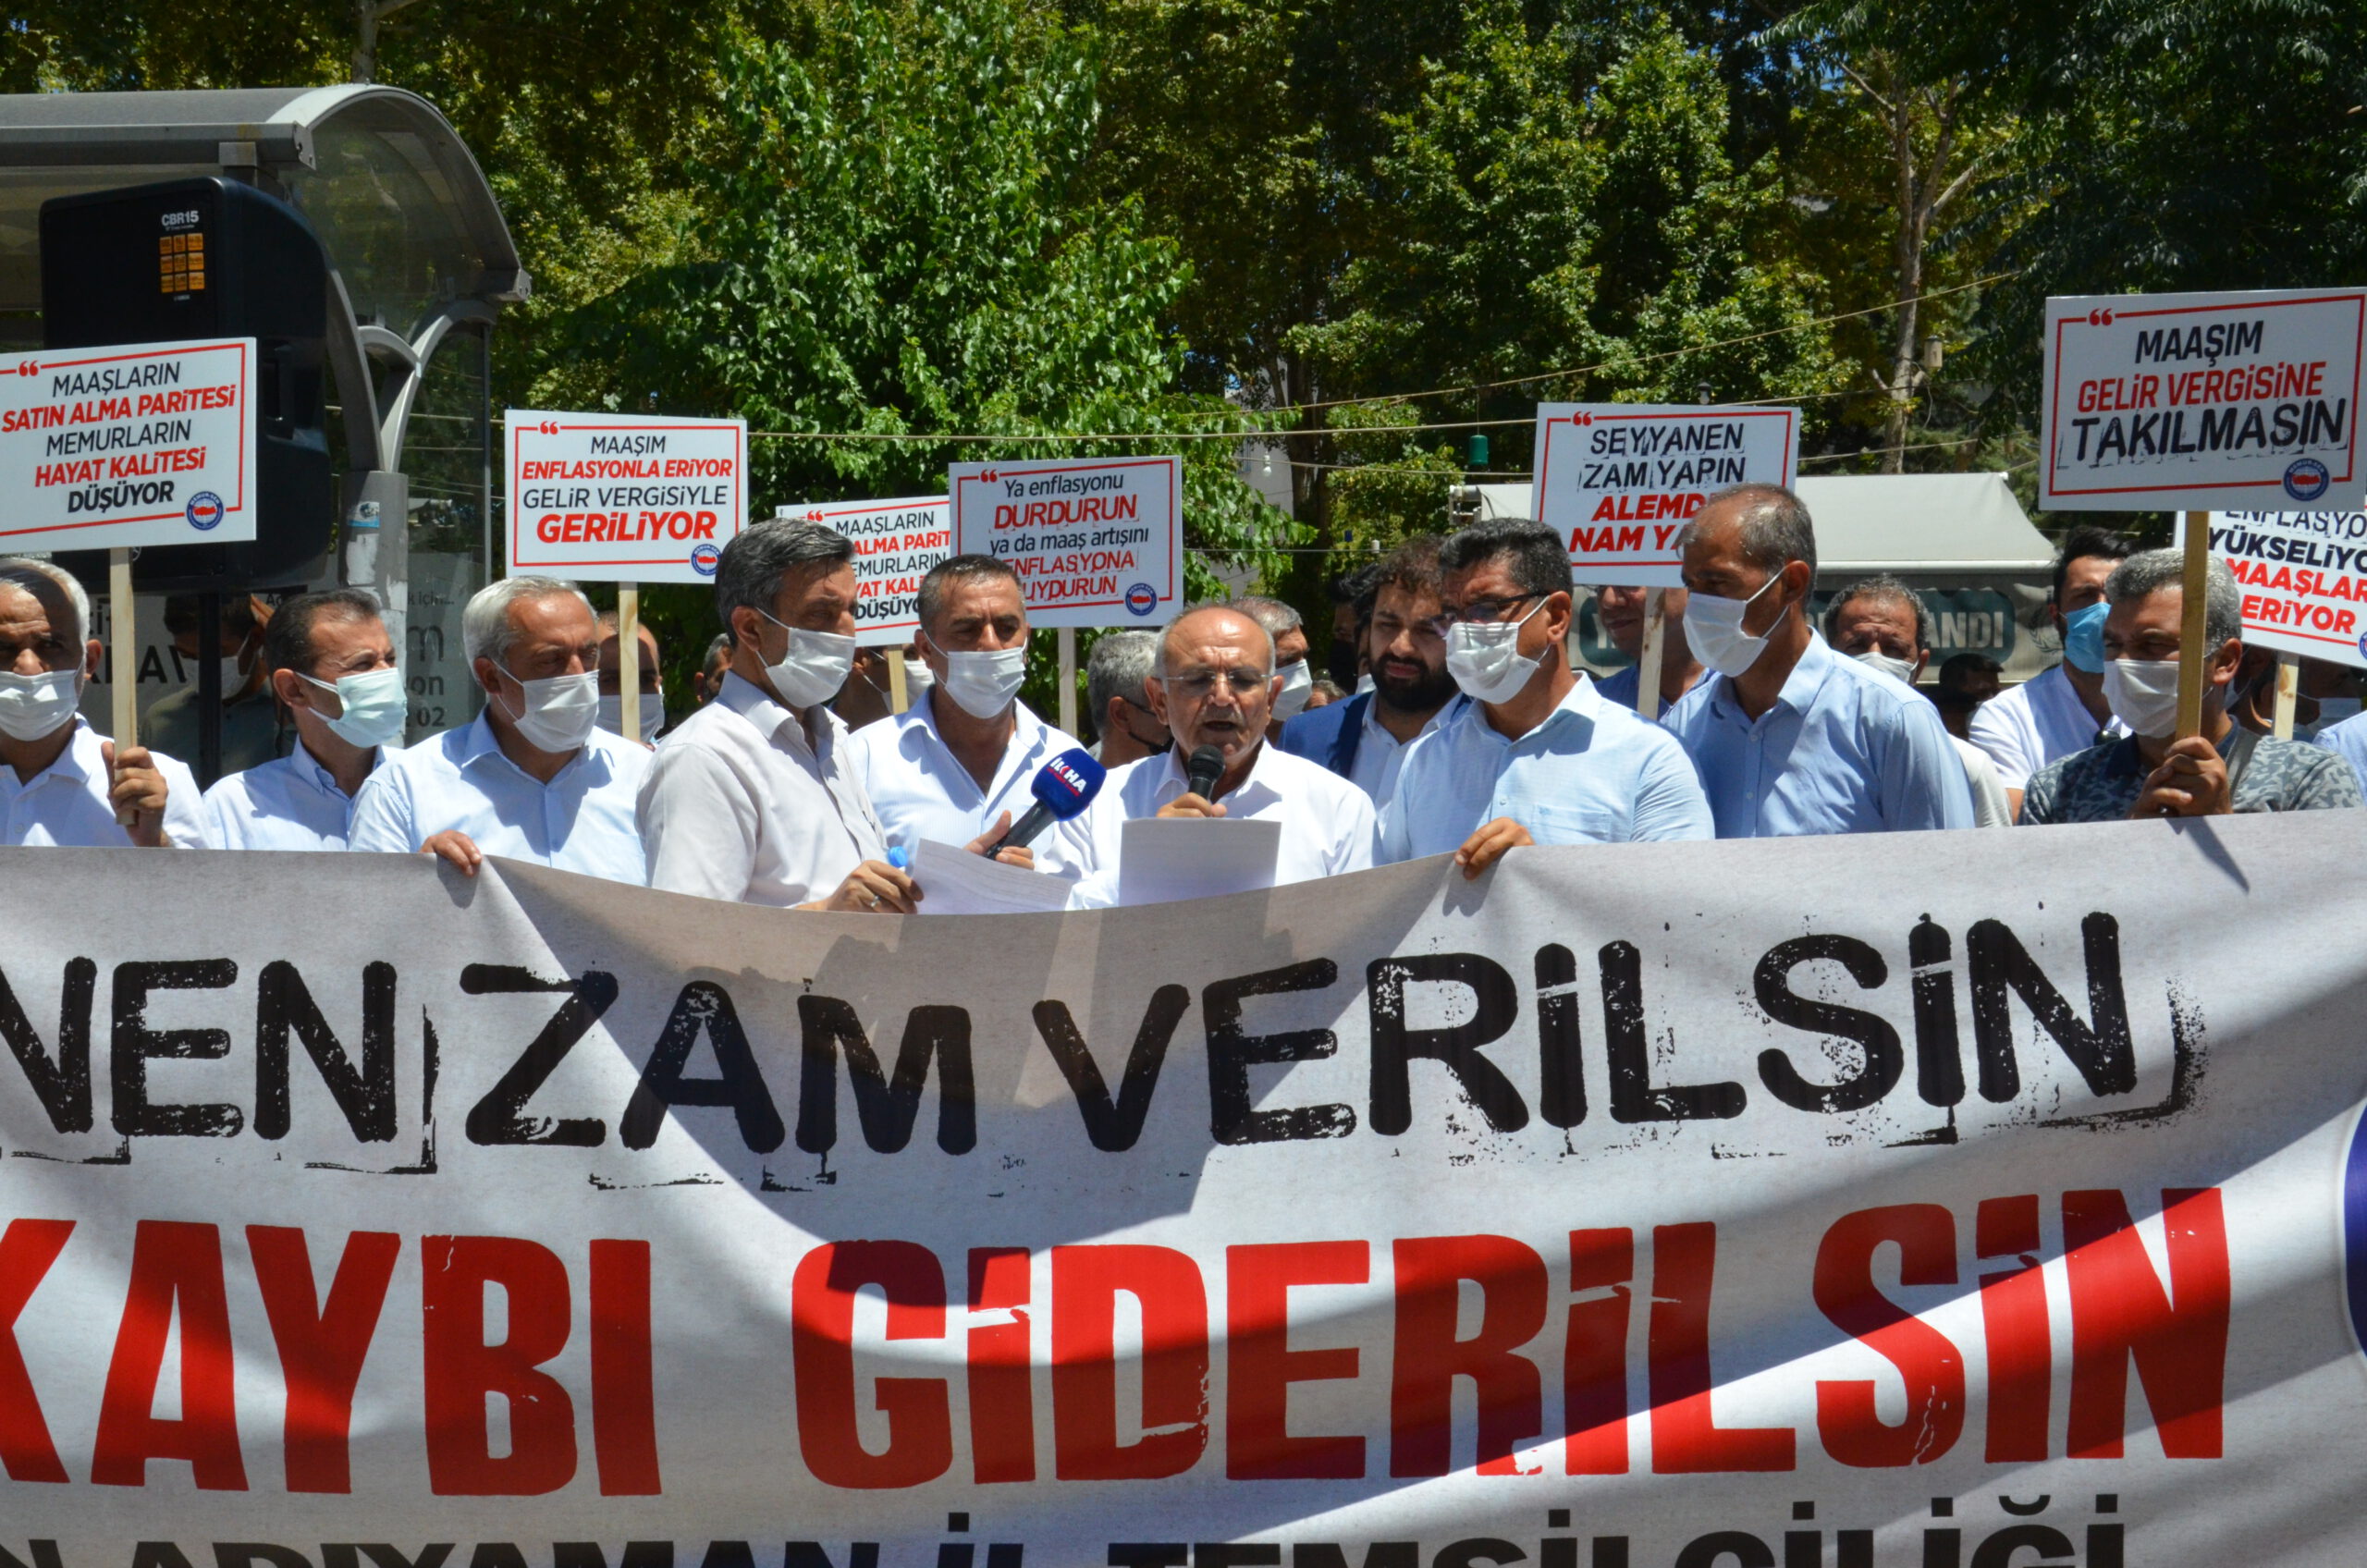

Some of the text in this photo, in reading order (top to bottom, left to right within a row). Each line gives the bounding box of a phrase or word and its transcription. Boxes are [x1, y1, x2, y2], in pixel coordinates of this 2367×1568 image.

[162, 210, 200, 227] CBR15
[2135, 321, 2264, 367] MAAŞIM
[53, 361, 180, 397] MAAŞLARIN
[2, 404, 66, 433] SATIN
[69, 398, 131, 424] ALMA
[2071, 398, 2347, 462] TAKILMASIN
[46, 419, 191, 457] MEMURLARIN
[590, 435, 667, 456] MAAŞIM
[1590, 423, 1745, 456] SEYYANEN
[35, 459, 105, 487] HAYAT
[521, 460, 660, 480] ENFLASYONLA
[1583, 457, 1746, 489] ZAM YAPIN
[67, 480, 174, 513] DÜŞÜYOR
[1004, 474, 1123, 497] Ya enflasyonu
[994, 494, 1137, 530] DURDURUN
[1591, 493, 1711, 521] ALEMD
[836, 510, 934, 536] MAAŞLARIN
[853, 536, 900, 556] ALMA
[990, 527, 1149, 557] ya da maaş artışını
[1568, 525, 1645, 553] NAM
[1001, 550, 1134, 576] NFLASYONA
[1022, 575, 1117, 600] UYDURUN
[460, 962, 978, 1156] ZAM
[791, 1187, 2232, 1489] GİDERİLSİN
